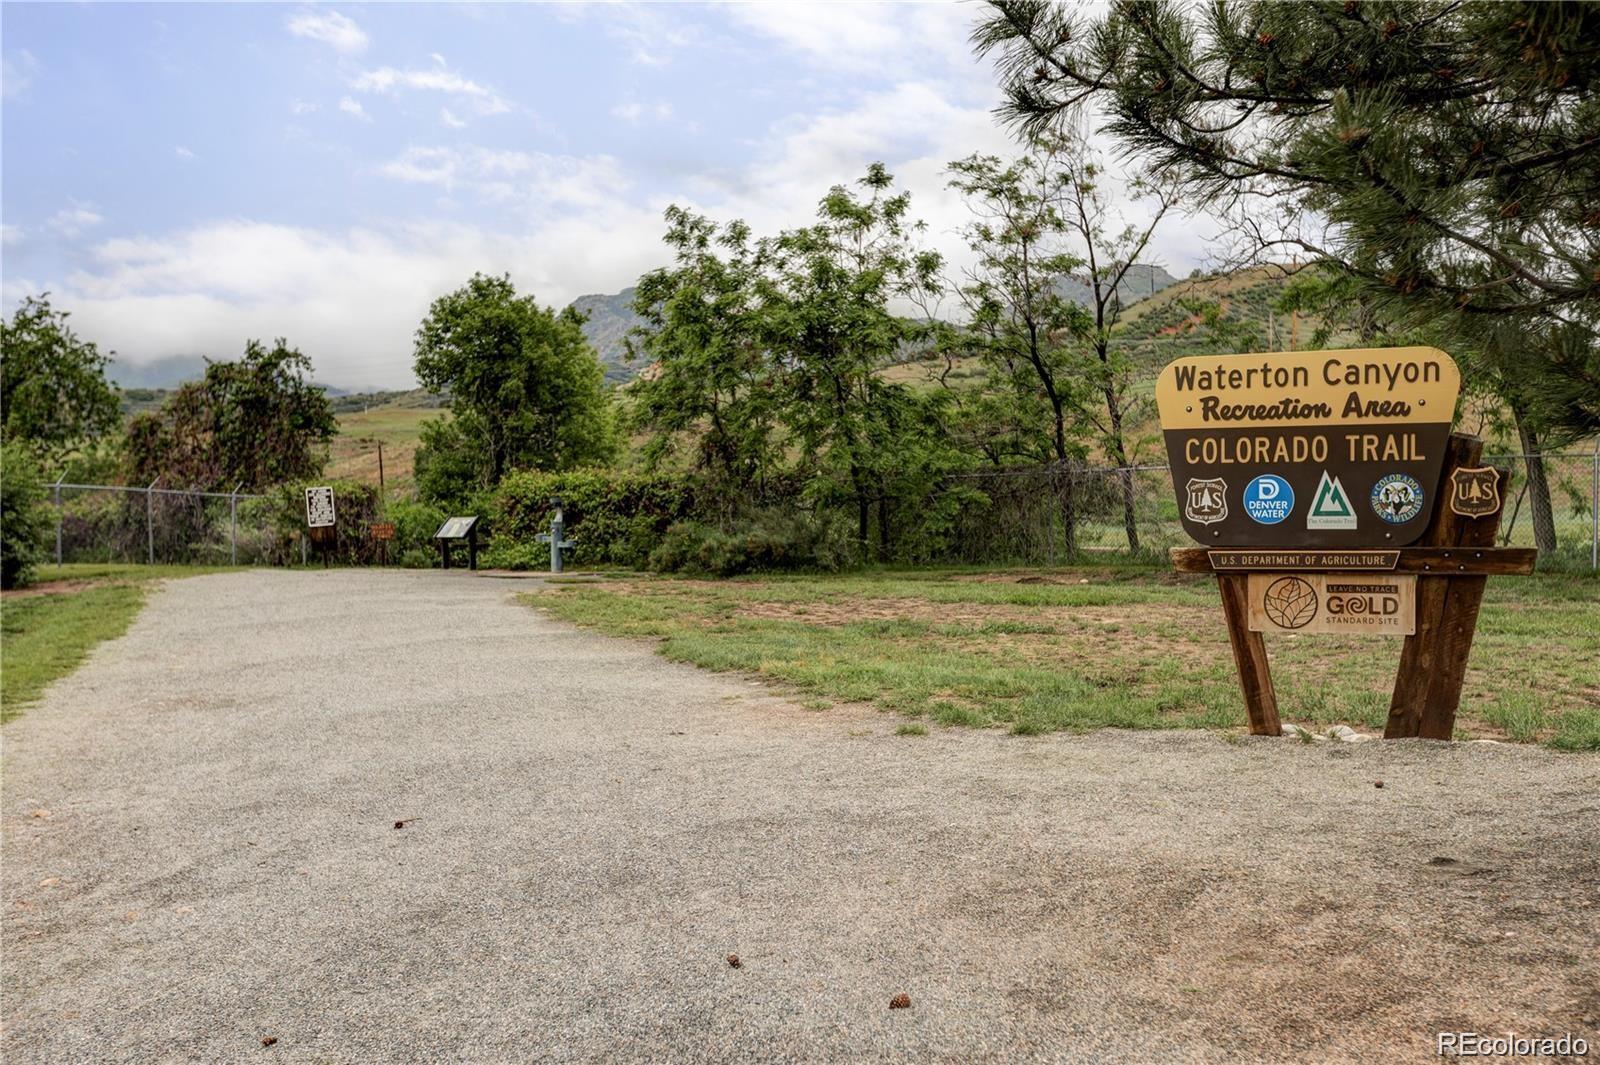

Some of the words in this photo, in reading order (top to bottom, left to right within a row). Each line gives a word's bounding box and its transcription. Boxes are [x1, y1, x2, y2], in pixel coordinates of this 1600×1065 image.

[1174, 362, 1309, 391] Waterton
[1322, 359, 1441, 391] Canyon
[1199, 396, 1332, 422] Recreation
[1341, 391, 1412, 418] Area
[1185, 436, 1329, 465] COLORADO
[1345, 433, 1426, 462] TRAIL
[1374, 474, 1419, 491] COLORADO
[1249, 501, 1288, 510] DENVER
[1252, 510, 1285, 518] WATER
[1371, 495, 1388, 519] PARKS
[1392, 494, 1423, 523] WILDLIFE
[1221, 557, 1238, 565] U.S.
[1242, 556, 1300, 565] DEPARTMENT
[1305, 556, 1316, 565] OF
[1321, 555, 1386, 565] AGRICULTURE
[1326, 595, 1399, 616] GOLD
[1326, 616, 1375, 625] STANDARD
[1378, 617, 1399, 625] SITE
